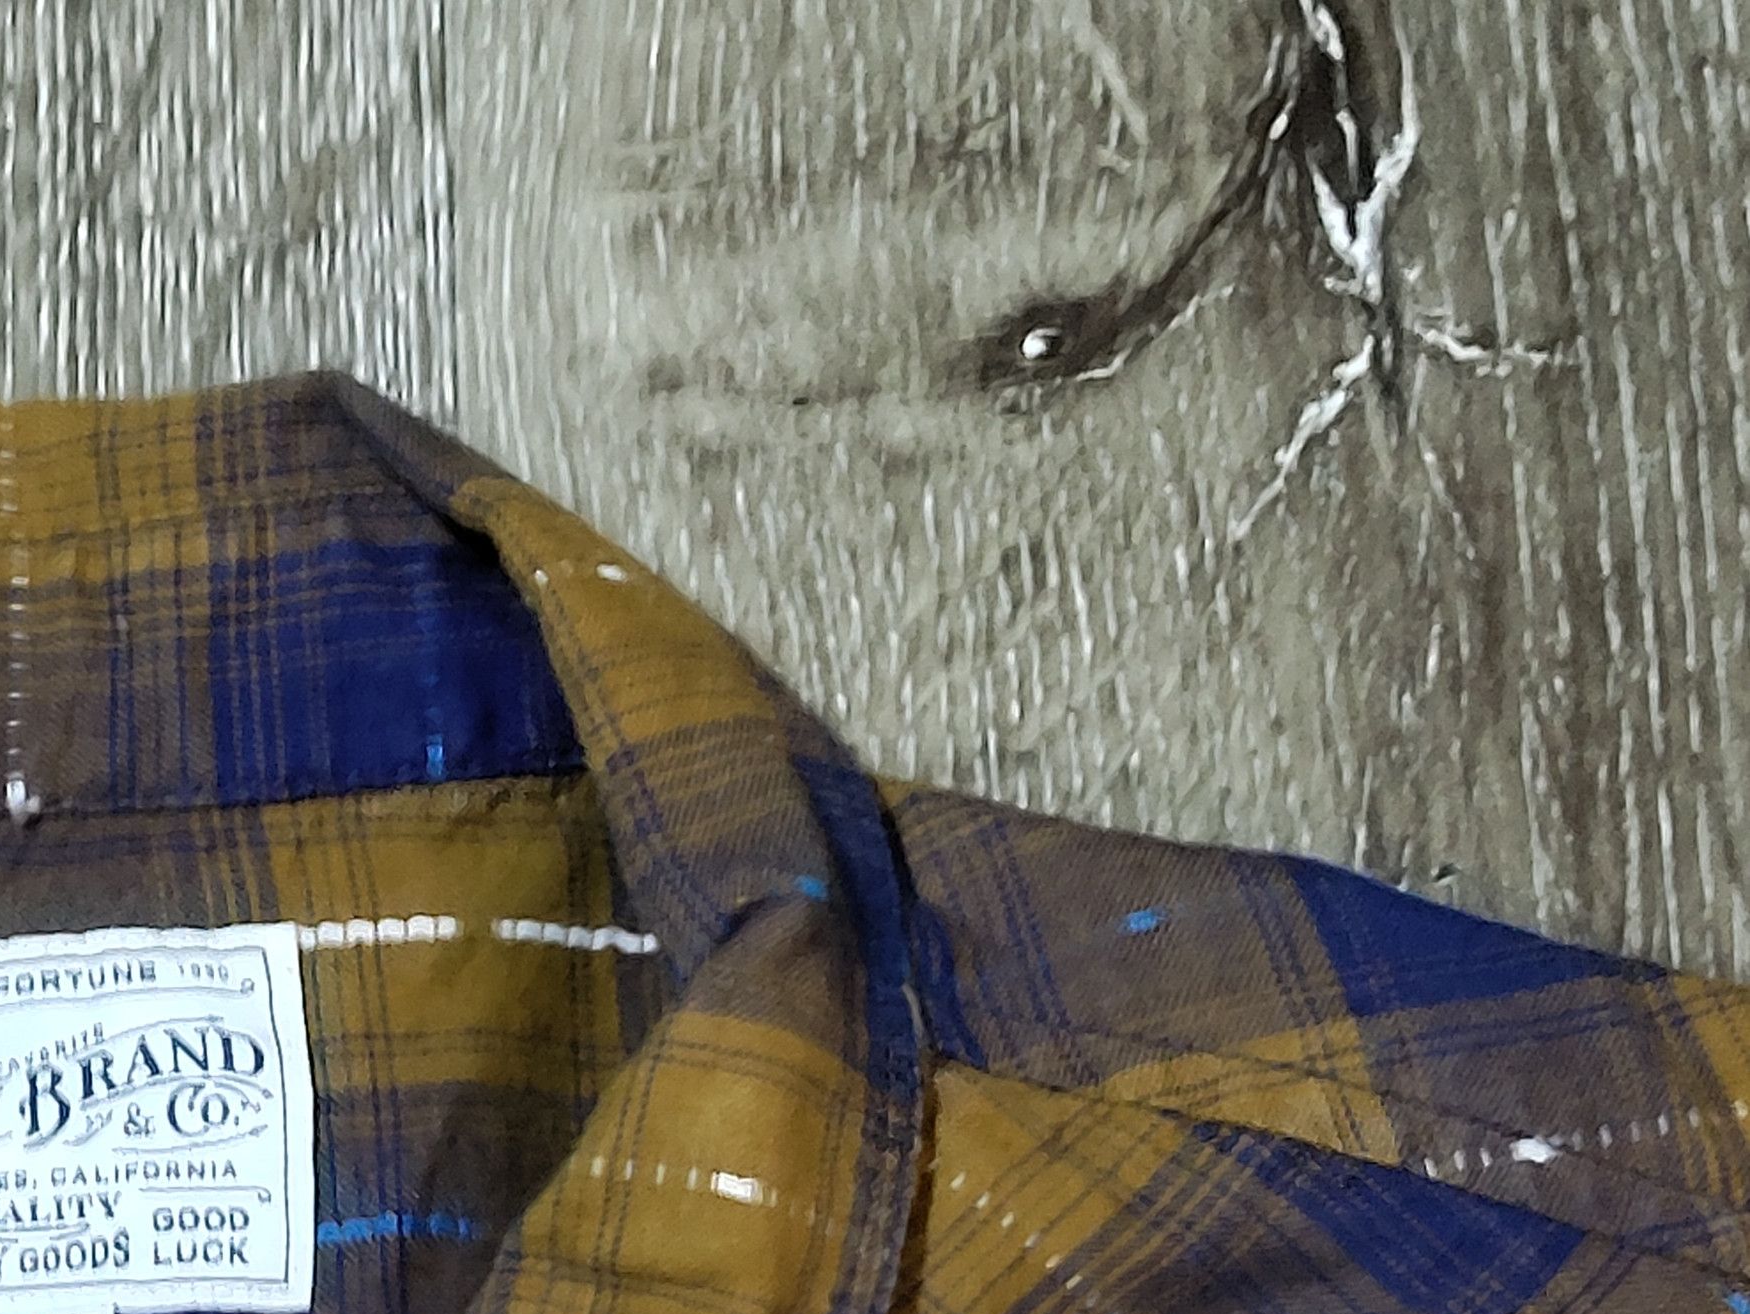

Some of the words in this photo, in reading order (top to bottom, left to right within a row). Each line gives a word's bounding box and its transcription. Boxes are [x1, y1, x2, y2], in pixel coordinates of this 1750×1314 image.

[19, 1023, 265, 1148] BRAND
[123, 1102, 156, 1137] &
[51, 1159, 238, 1188] CALIFORNIA
[153, 1205, 250, 1232] GOOD
[19, 1227, 130, 1274] GOODS
[153, 1236, 249, 1267] LUCK
